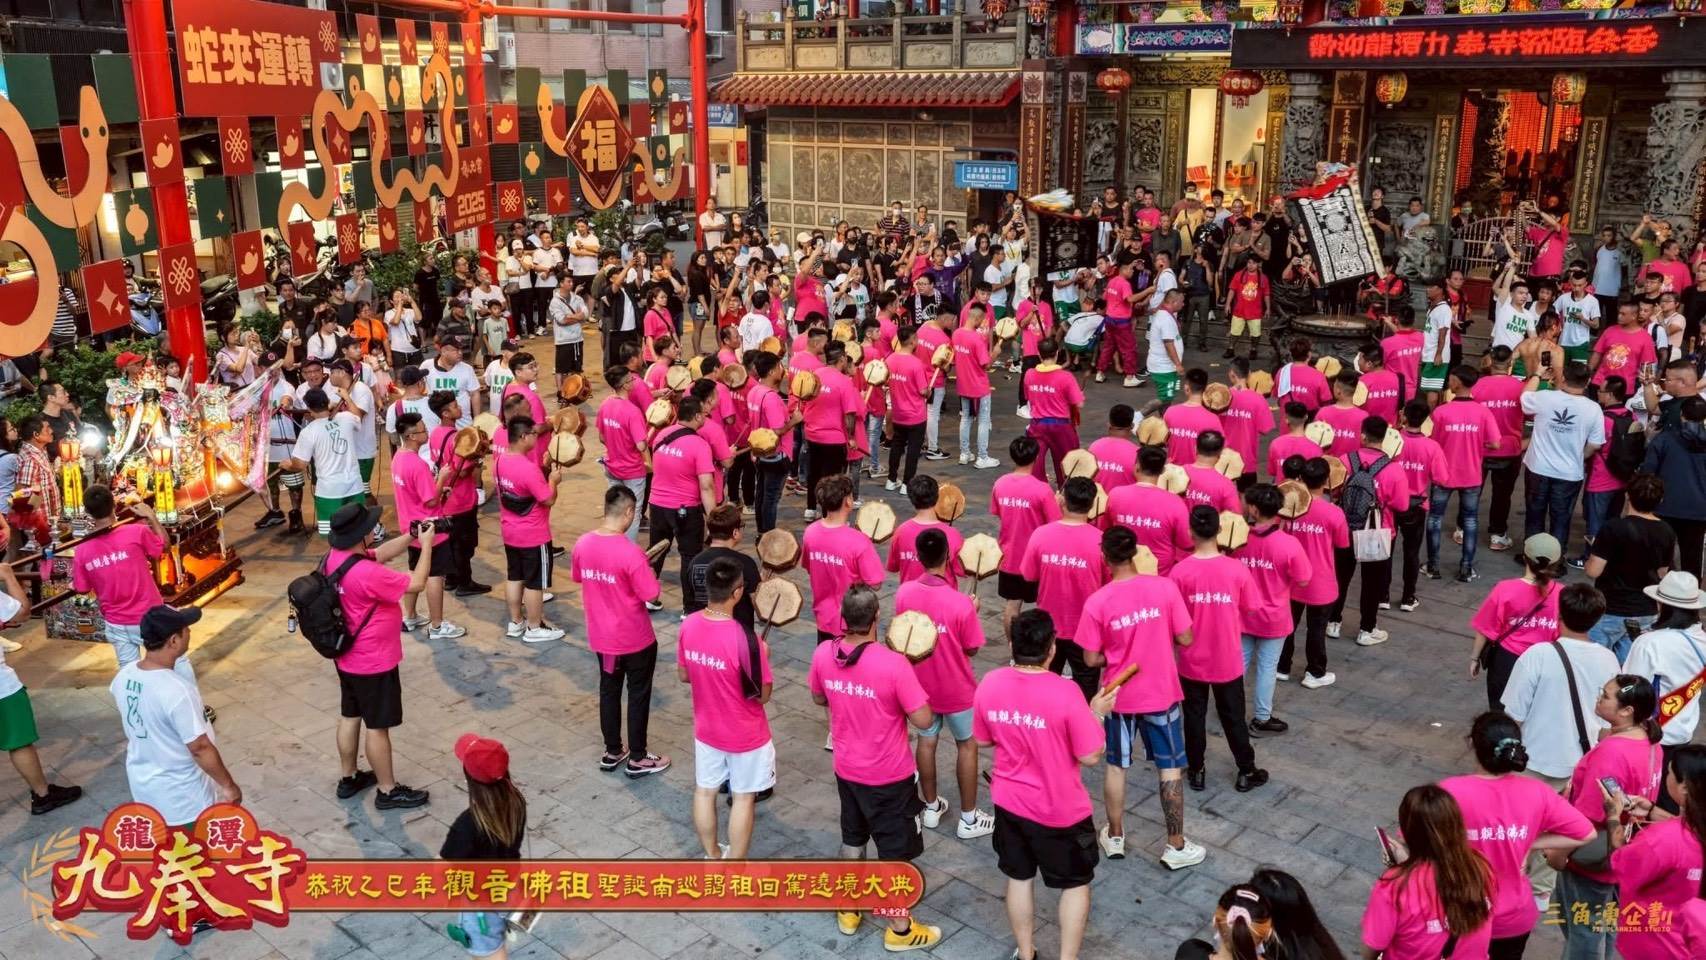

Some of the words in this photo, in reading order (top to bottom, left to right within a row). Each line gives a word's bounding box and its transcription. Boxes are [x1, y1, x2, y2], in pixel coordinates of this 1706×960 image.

[183, 24, 313, 87] 蛇來運轉
[581, 120, 617, 172] 福
[458, 190, 486, 217] 2025
[435, 378, 457, 389] LIN
[998, 711, 1047, 729] 觀音佛祖
